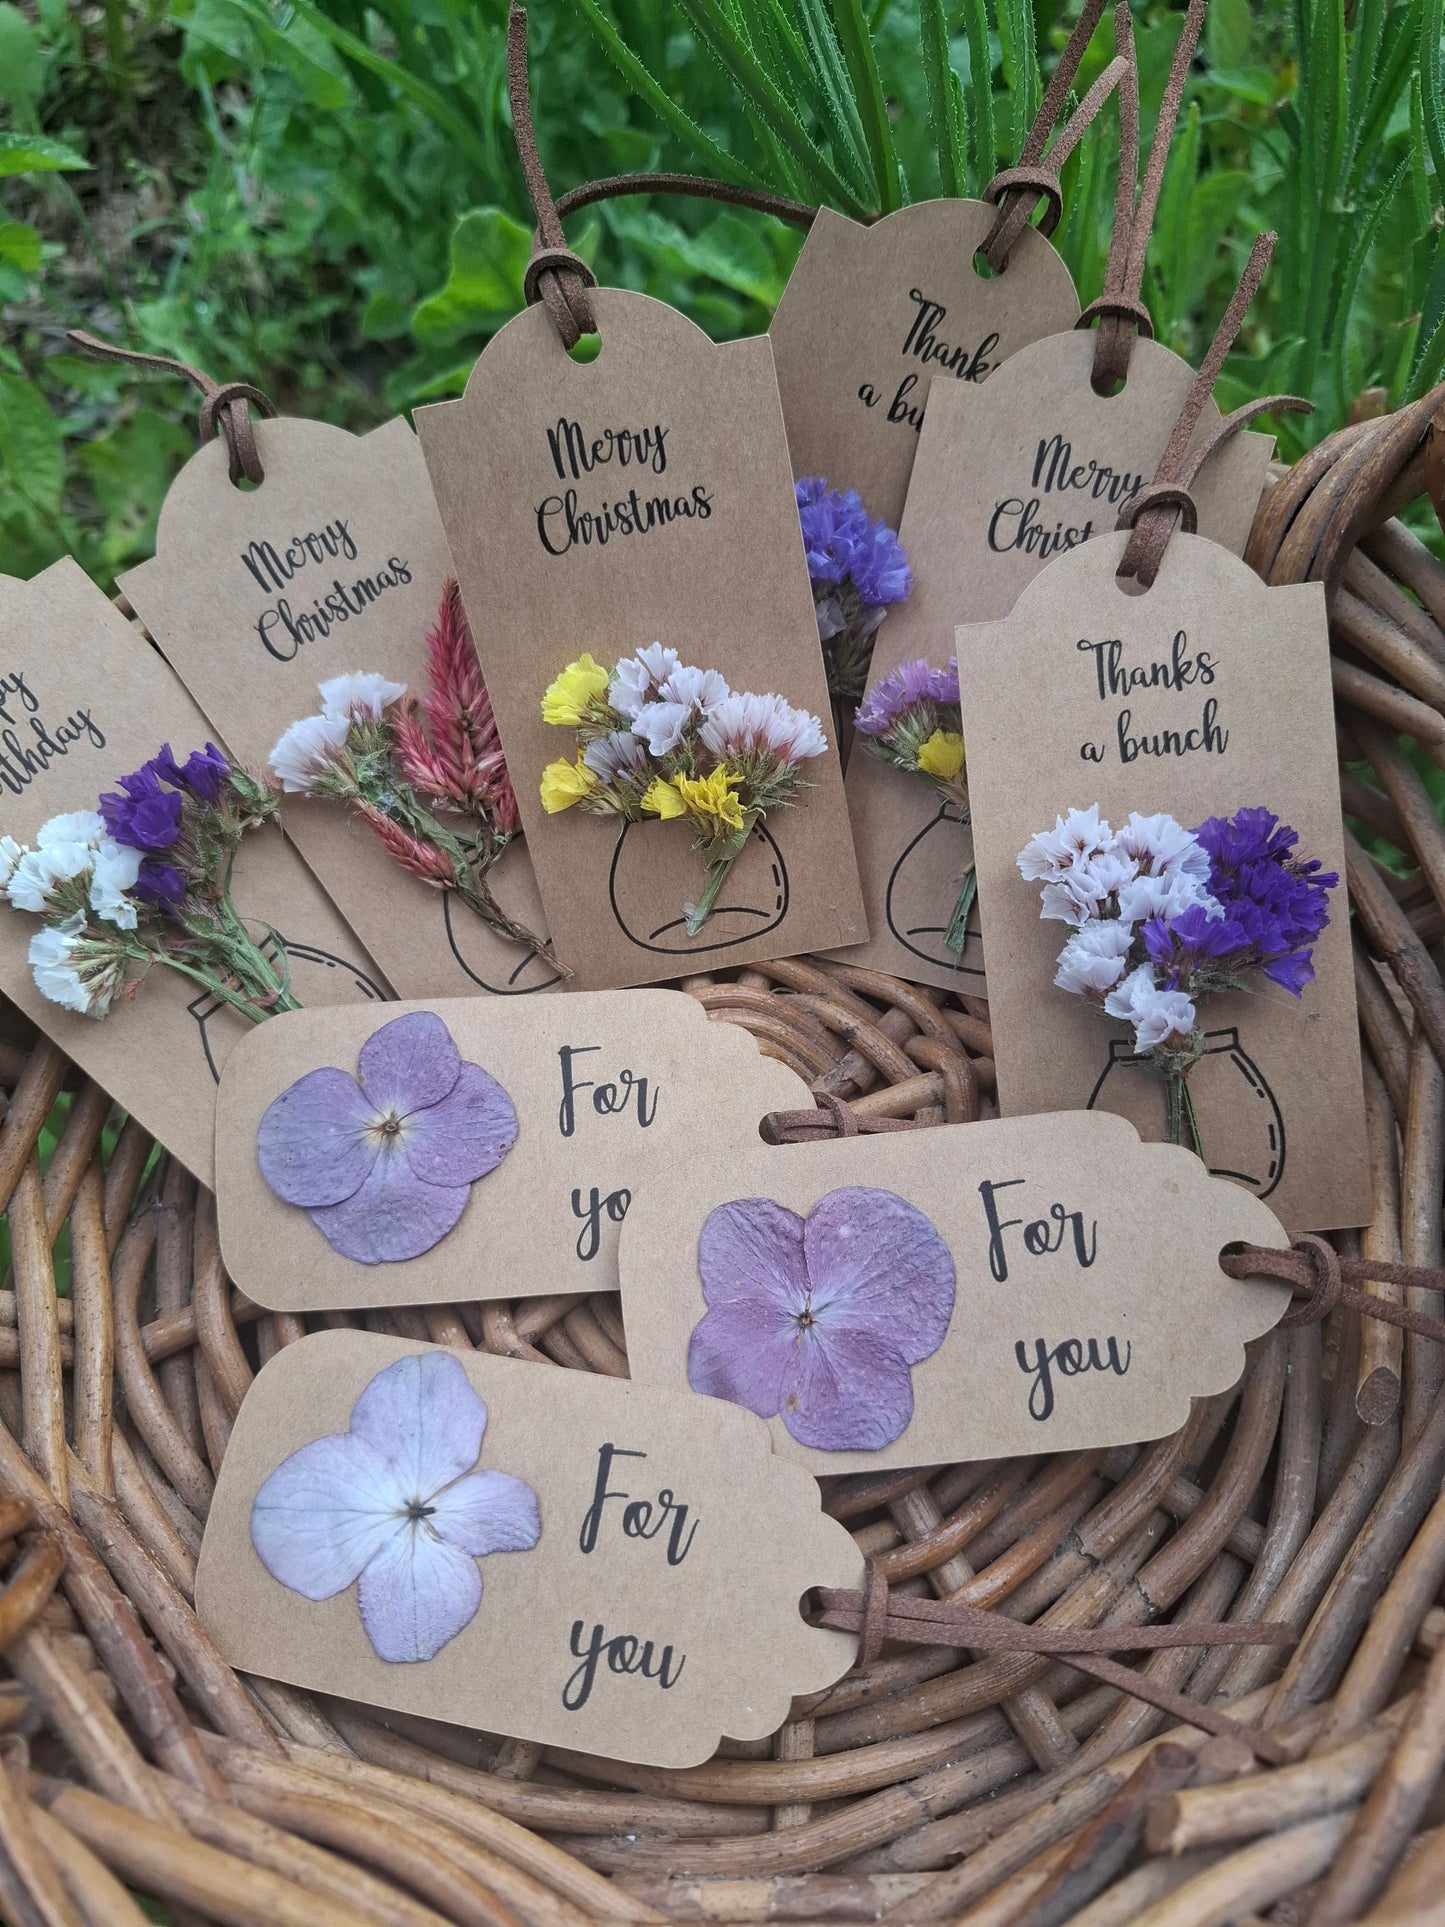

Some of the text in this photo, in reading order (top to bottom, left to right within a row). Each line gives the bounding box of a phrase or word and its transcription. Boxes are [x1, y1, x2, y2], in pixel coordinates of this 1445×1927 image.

[902, 288, 1001, 382] Thank
[857, 384, 882, 407] a
[546, 417, 669, 479] Merry
[1031, 434, 1148, 514] Merry
[241, 519, 358, 594] Merry
[533, 486, 714, 556] Christmas
[987, 498, 1093, 559] Christ
[253, 557, 413, 662] Christmas
[1076, 630, 1220, 700] Thanks
[0, 708, 106, 795] rthday
[1080, 698, 1229, 763] a bunch
[557, 1045, 659, 1138] For
[571, 1187, 632, 1262] yo
[978, 1179, 1097, 1283] For
[1014, 1336, 1131, 1421] you
[579, 1442, 700, 1566] For
[561, 1620, 686, 1711] you
